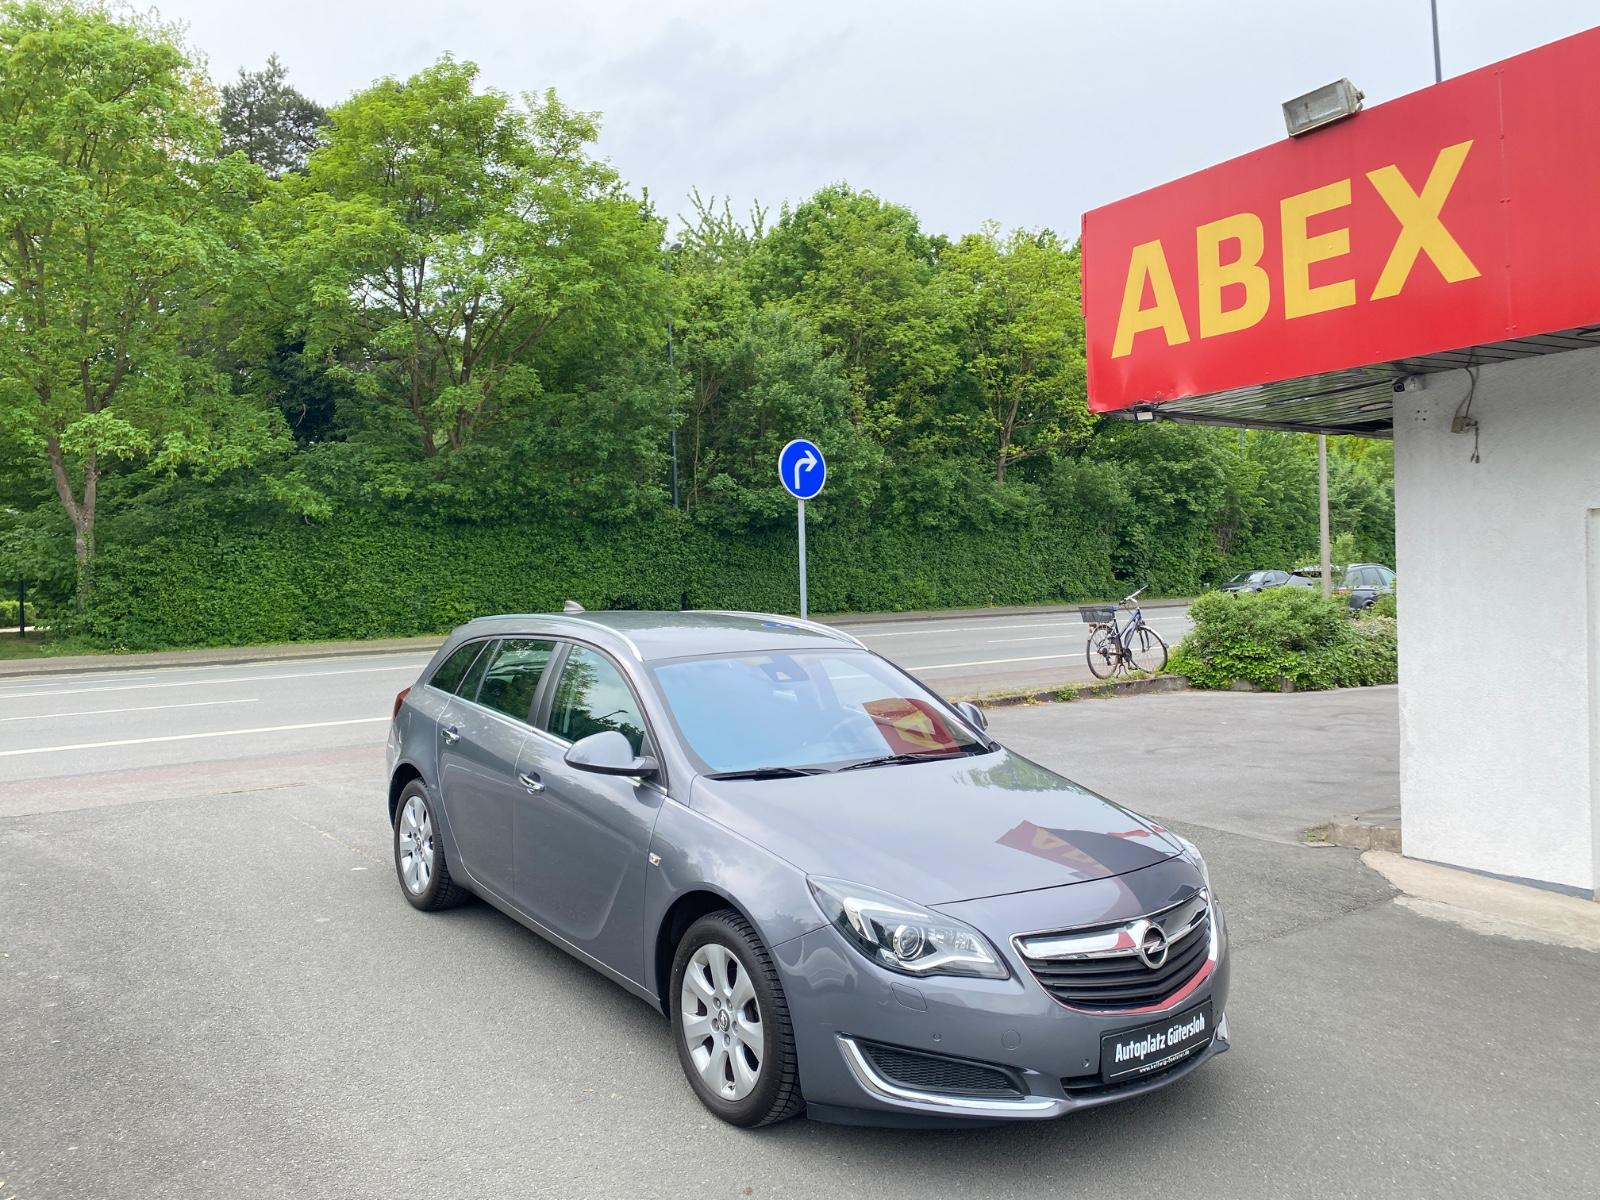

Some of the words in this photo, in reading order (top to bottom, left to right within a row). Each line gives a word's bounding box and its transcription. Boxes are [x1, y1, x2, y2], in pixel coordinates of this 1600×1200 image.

[1111, 139, 1482, 359] ABEX
[1115, 1034, 1166, 1063] Autoplatz
[1167, 1012, 1205, 1046] Gütersloh
